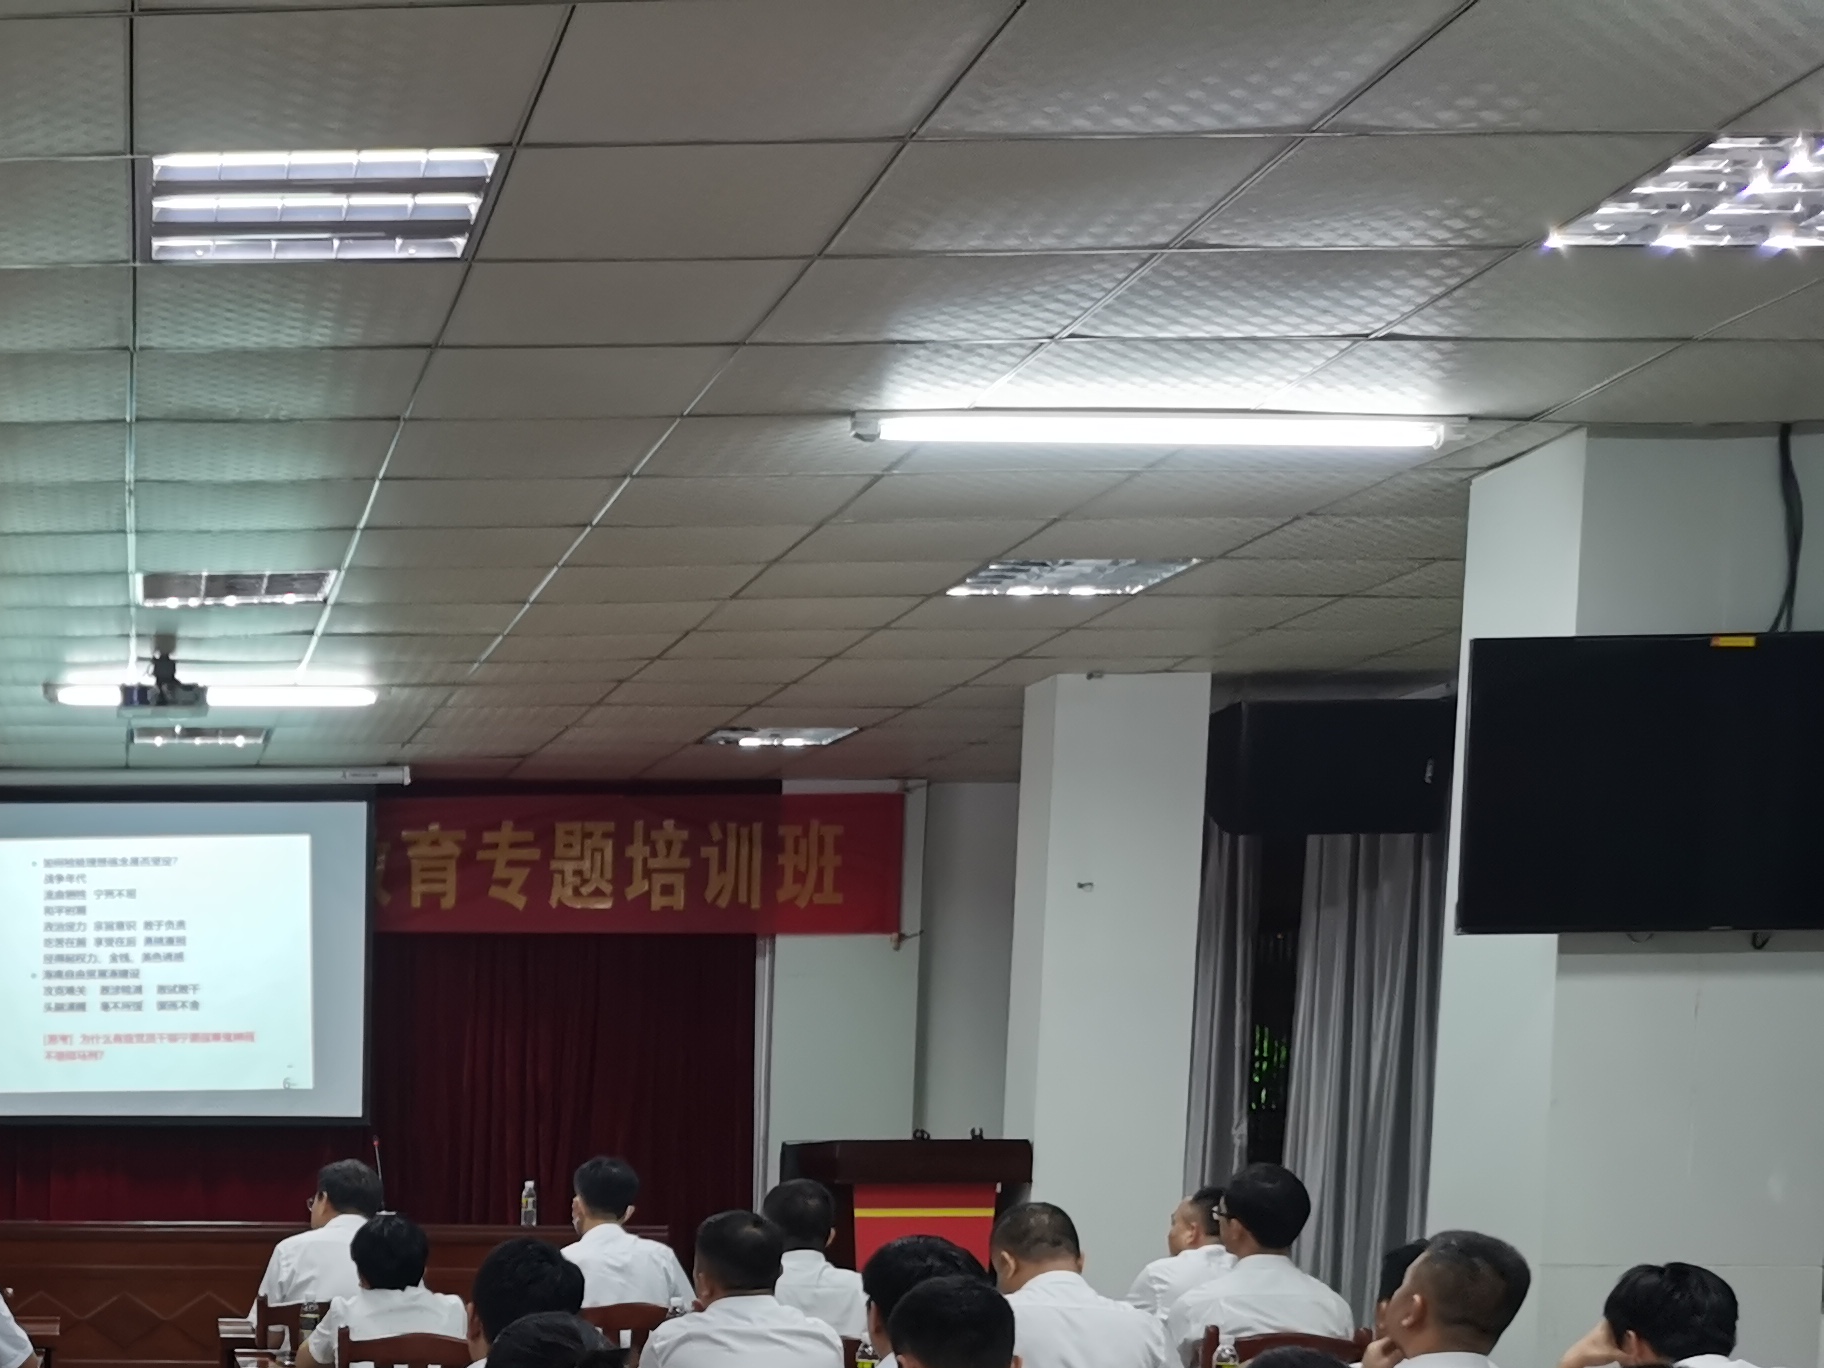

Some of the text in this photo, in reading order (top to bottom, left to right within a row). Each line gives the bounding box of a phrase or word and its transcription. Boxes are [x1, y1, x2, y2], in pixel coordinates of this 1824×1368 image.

[375, 819, 845, 911] 育专题培训班
